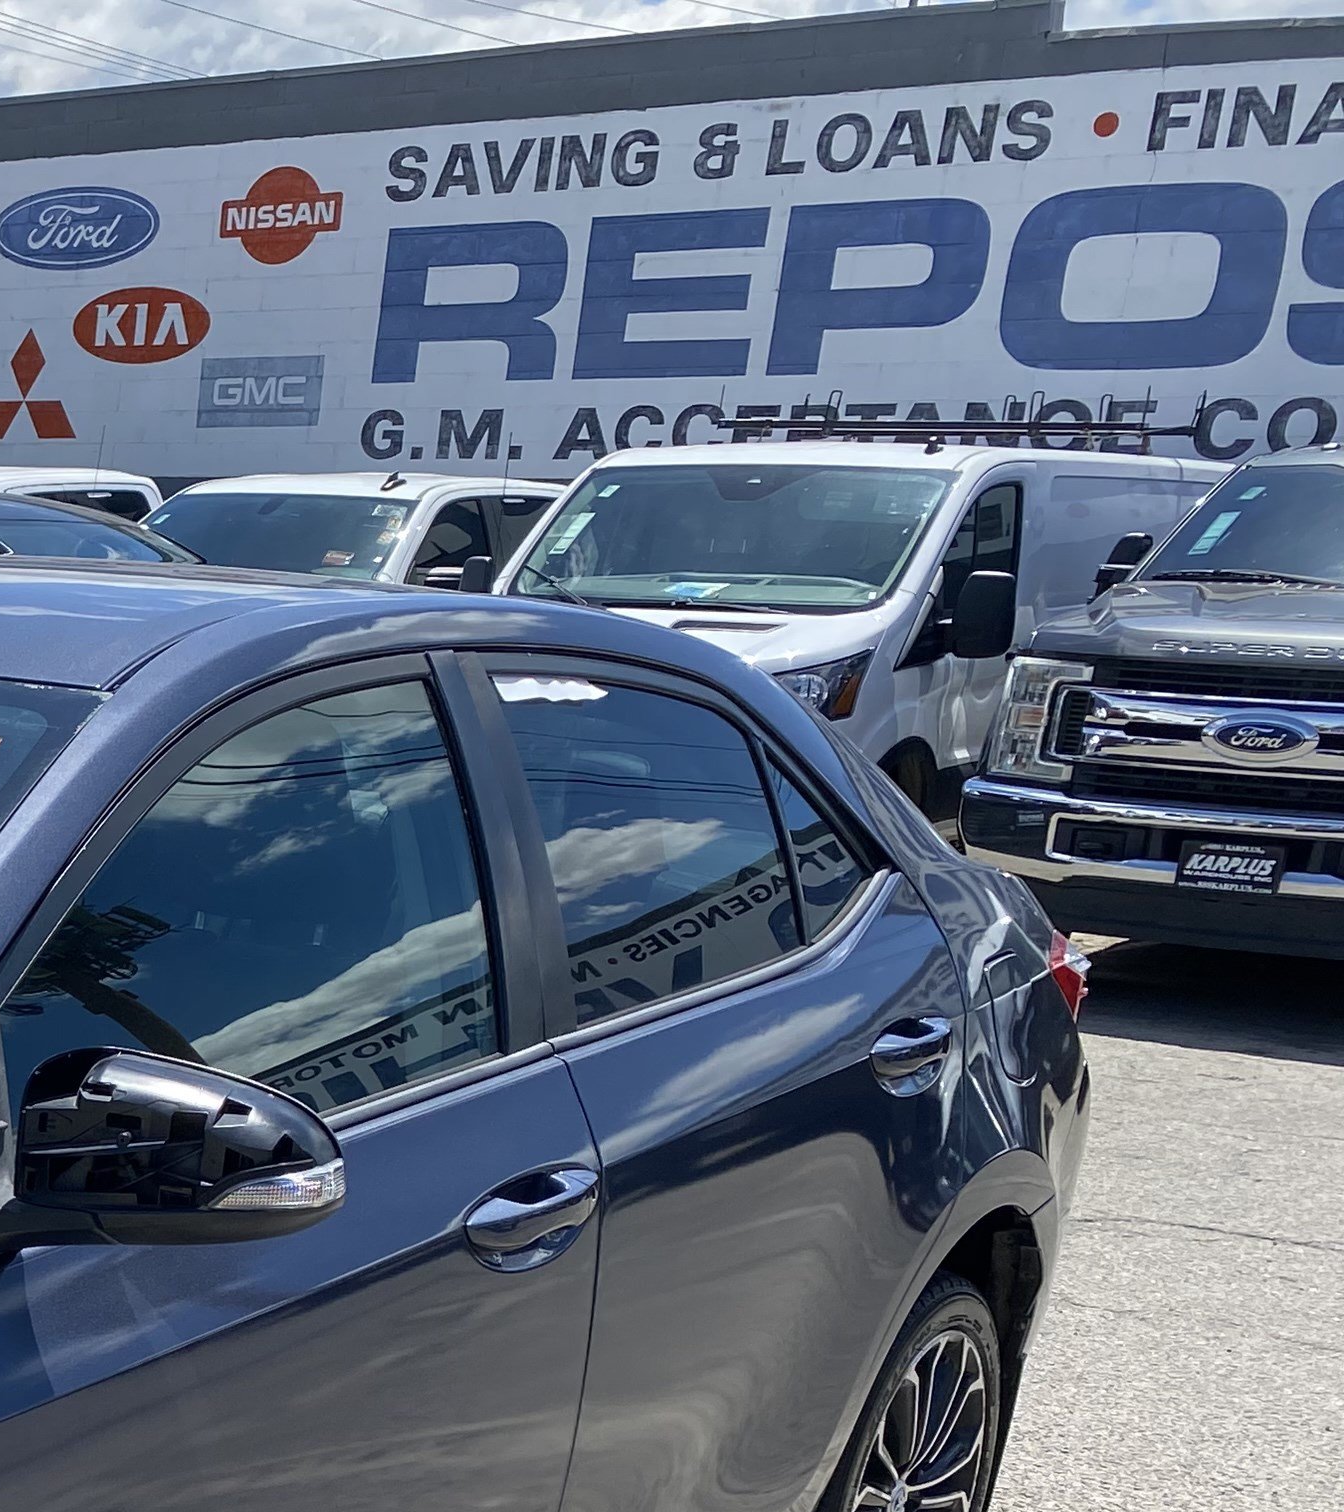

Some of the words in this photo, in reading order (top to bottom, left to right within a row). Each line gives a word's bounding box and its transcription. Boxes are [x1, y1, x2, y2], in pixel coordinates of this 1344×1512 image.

[385, 129, 660, 202] SAVING
[693, 123, 740, 179] &
[765, 100, 1054, 175] LOANS
[27, 203, 120, 250] Ford
[226, 200, 335, 230] NISSAN
[372, 181, 1344, 383] REPO
[94, 302, 189, 347] KIA
[213, 375, 306, 407] GMC
[360, 408, 523, 460] G.M.
[1231, 726, 1287, 749] Ford
[1185, 854, 1277, 876] KARPLUS
